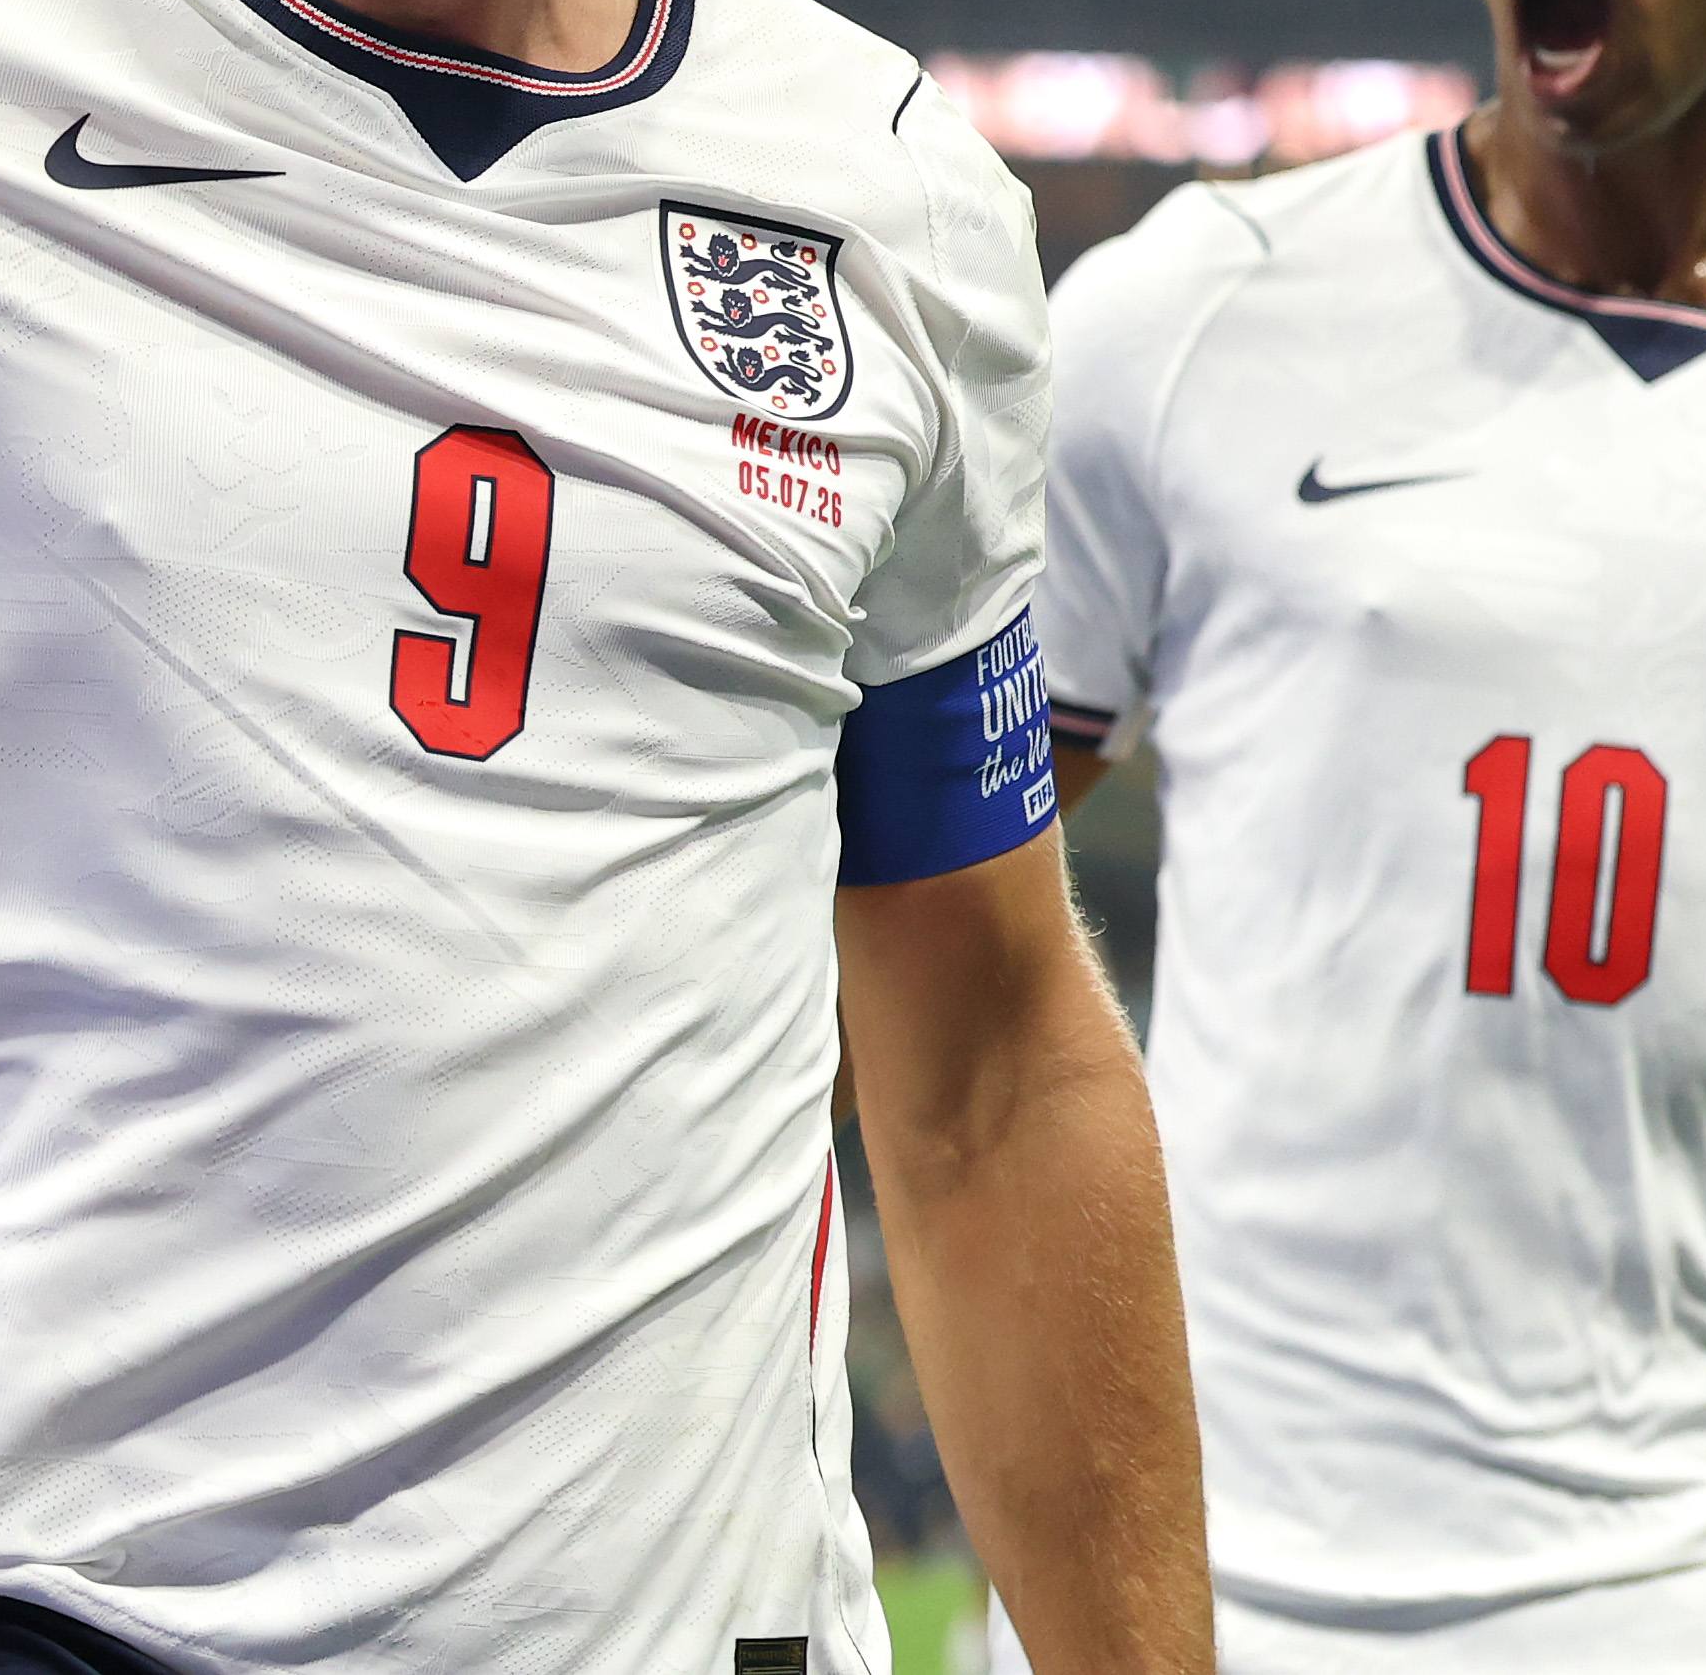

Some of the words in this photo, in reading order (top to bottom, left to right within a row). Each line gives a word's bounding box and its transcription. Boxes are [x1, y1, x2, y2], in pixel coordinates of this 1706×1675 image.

[732, 413, 841, 476] MEXICO
[739, 461, 842, 528] 05.07.26
[389, 422, 555, 762] 9
[974, 744, 1025, 799] the
[1464, 734, 1667, 1007] 10
